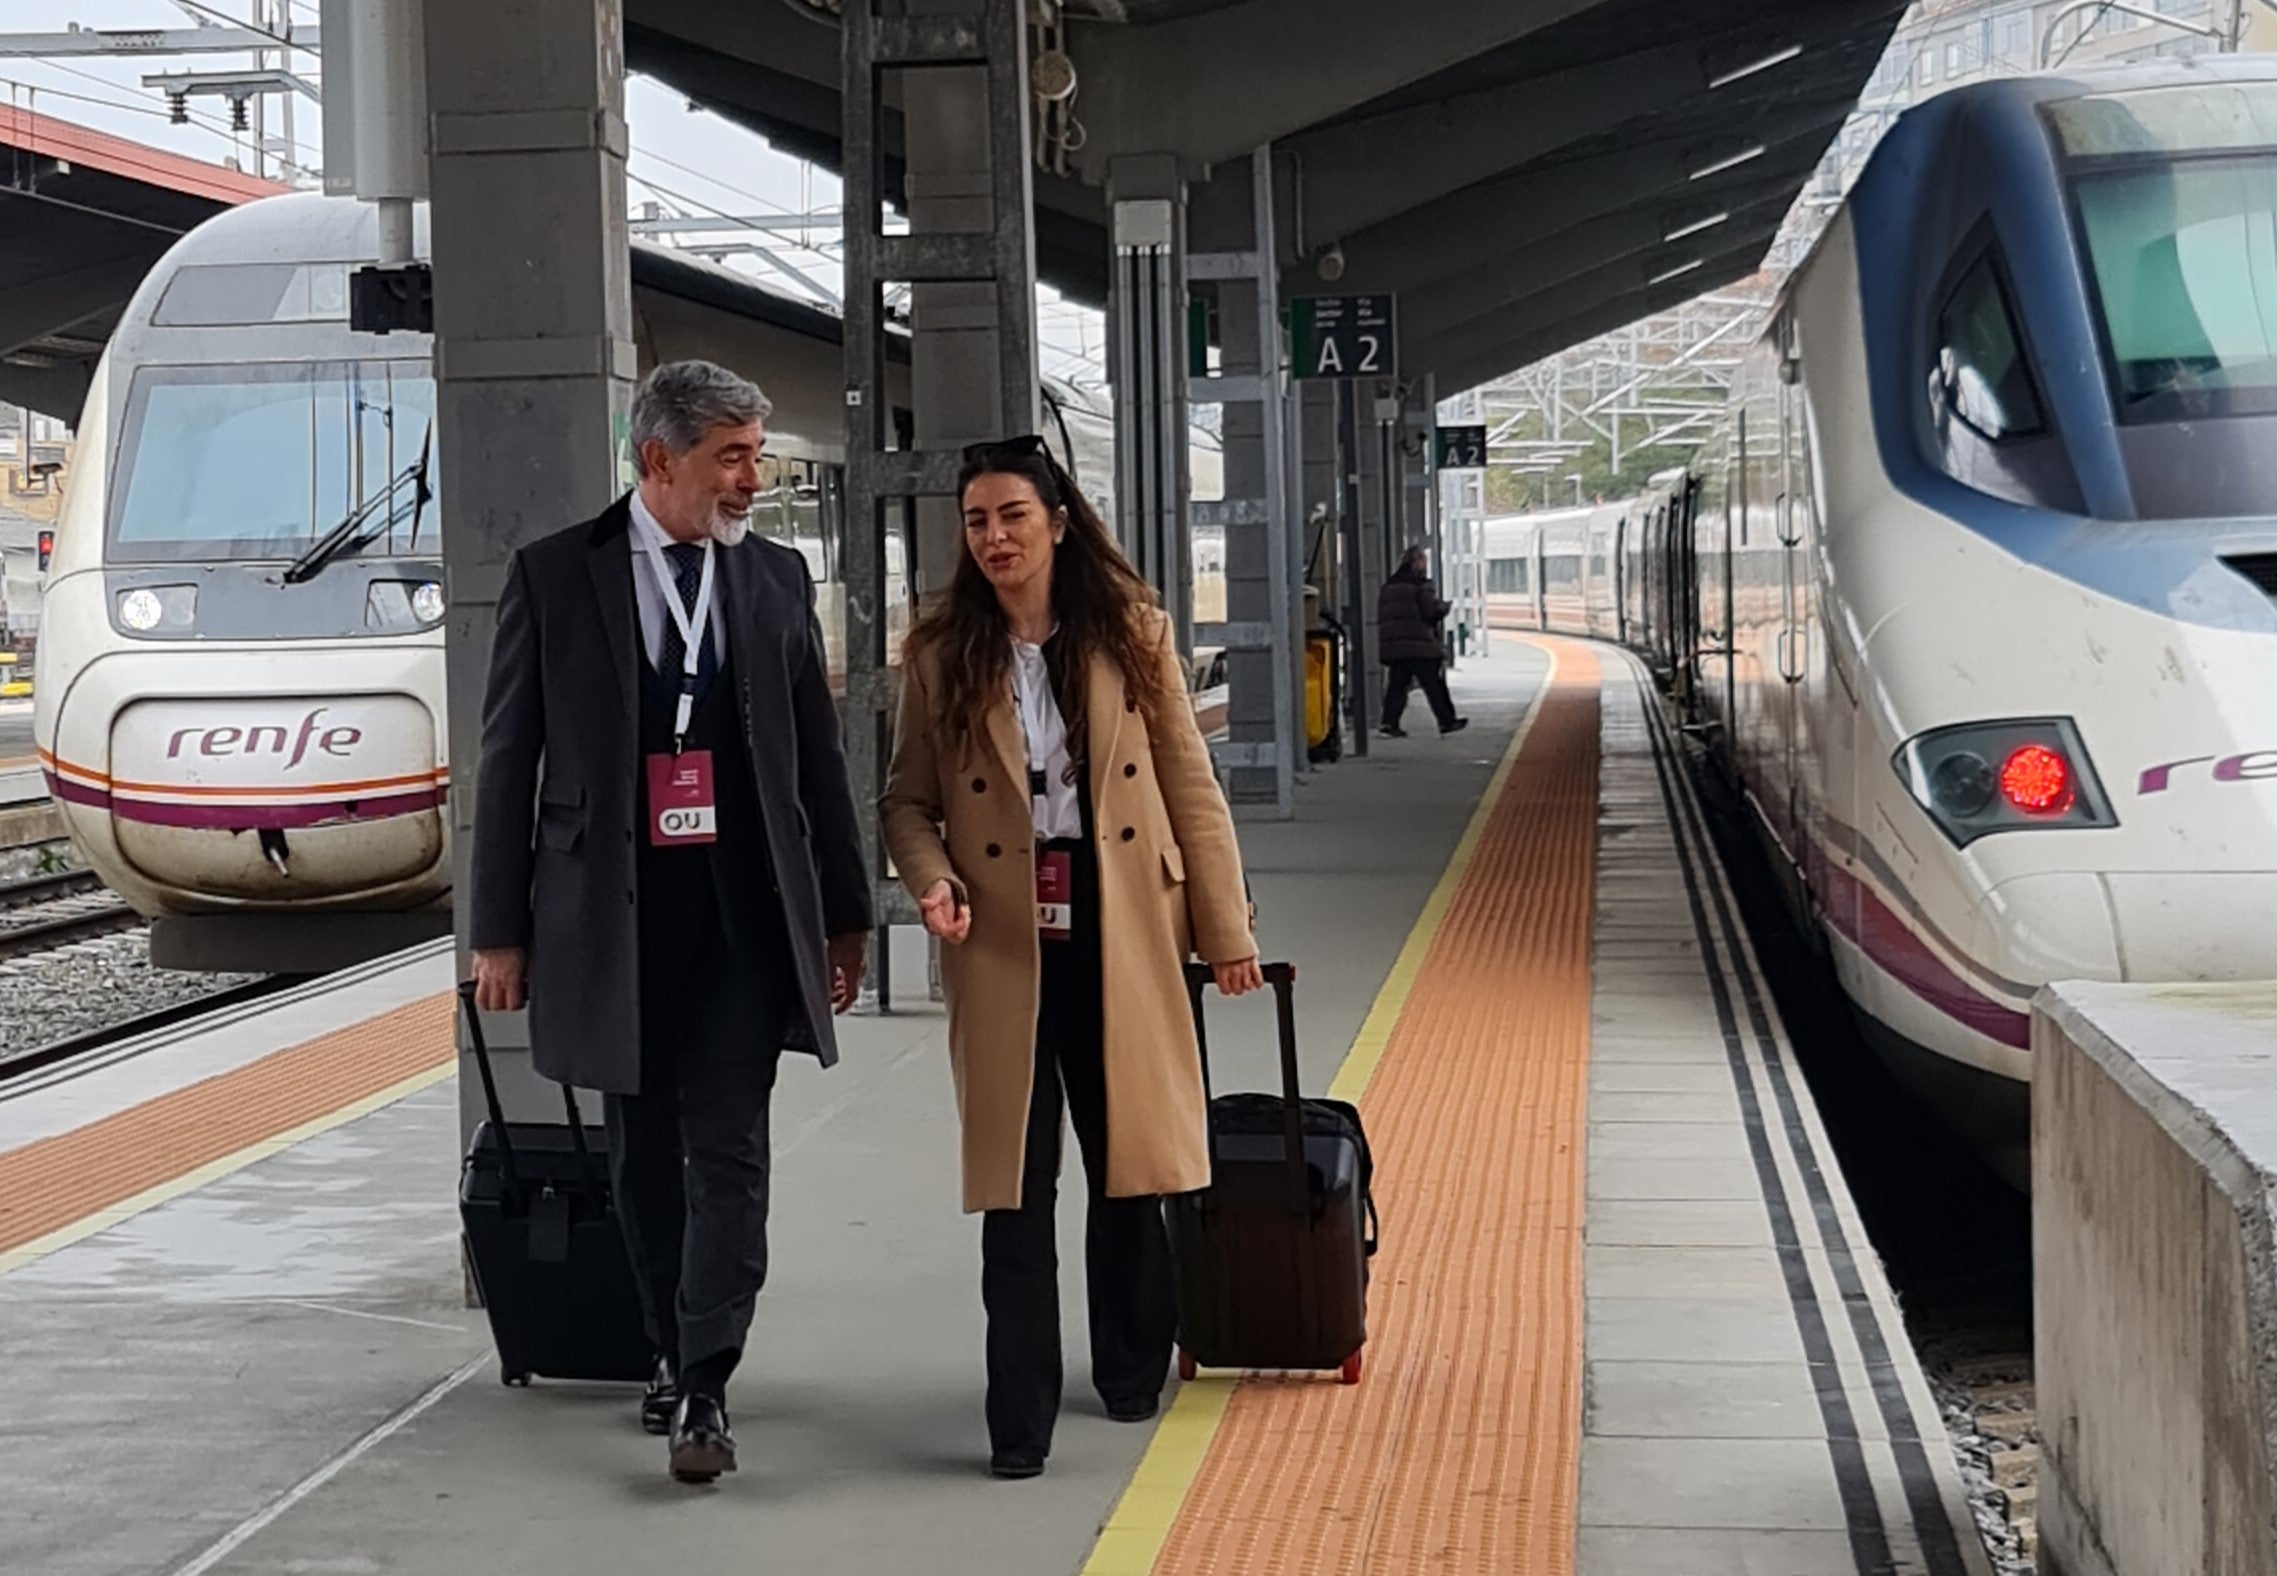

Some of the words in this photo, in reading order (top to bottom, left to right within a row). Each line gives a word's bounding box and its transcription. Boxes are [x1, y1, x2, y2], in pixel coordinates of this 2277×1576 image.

[1317, 336, 1343, 373] A
[1358, 335, 1379, 372] 2
[1446, 446, 1460, 466] A
[1467, 445, 1480, 466] 2
[167, 707, 362, 771] renfe
[665, 812, 700, 831] OU
